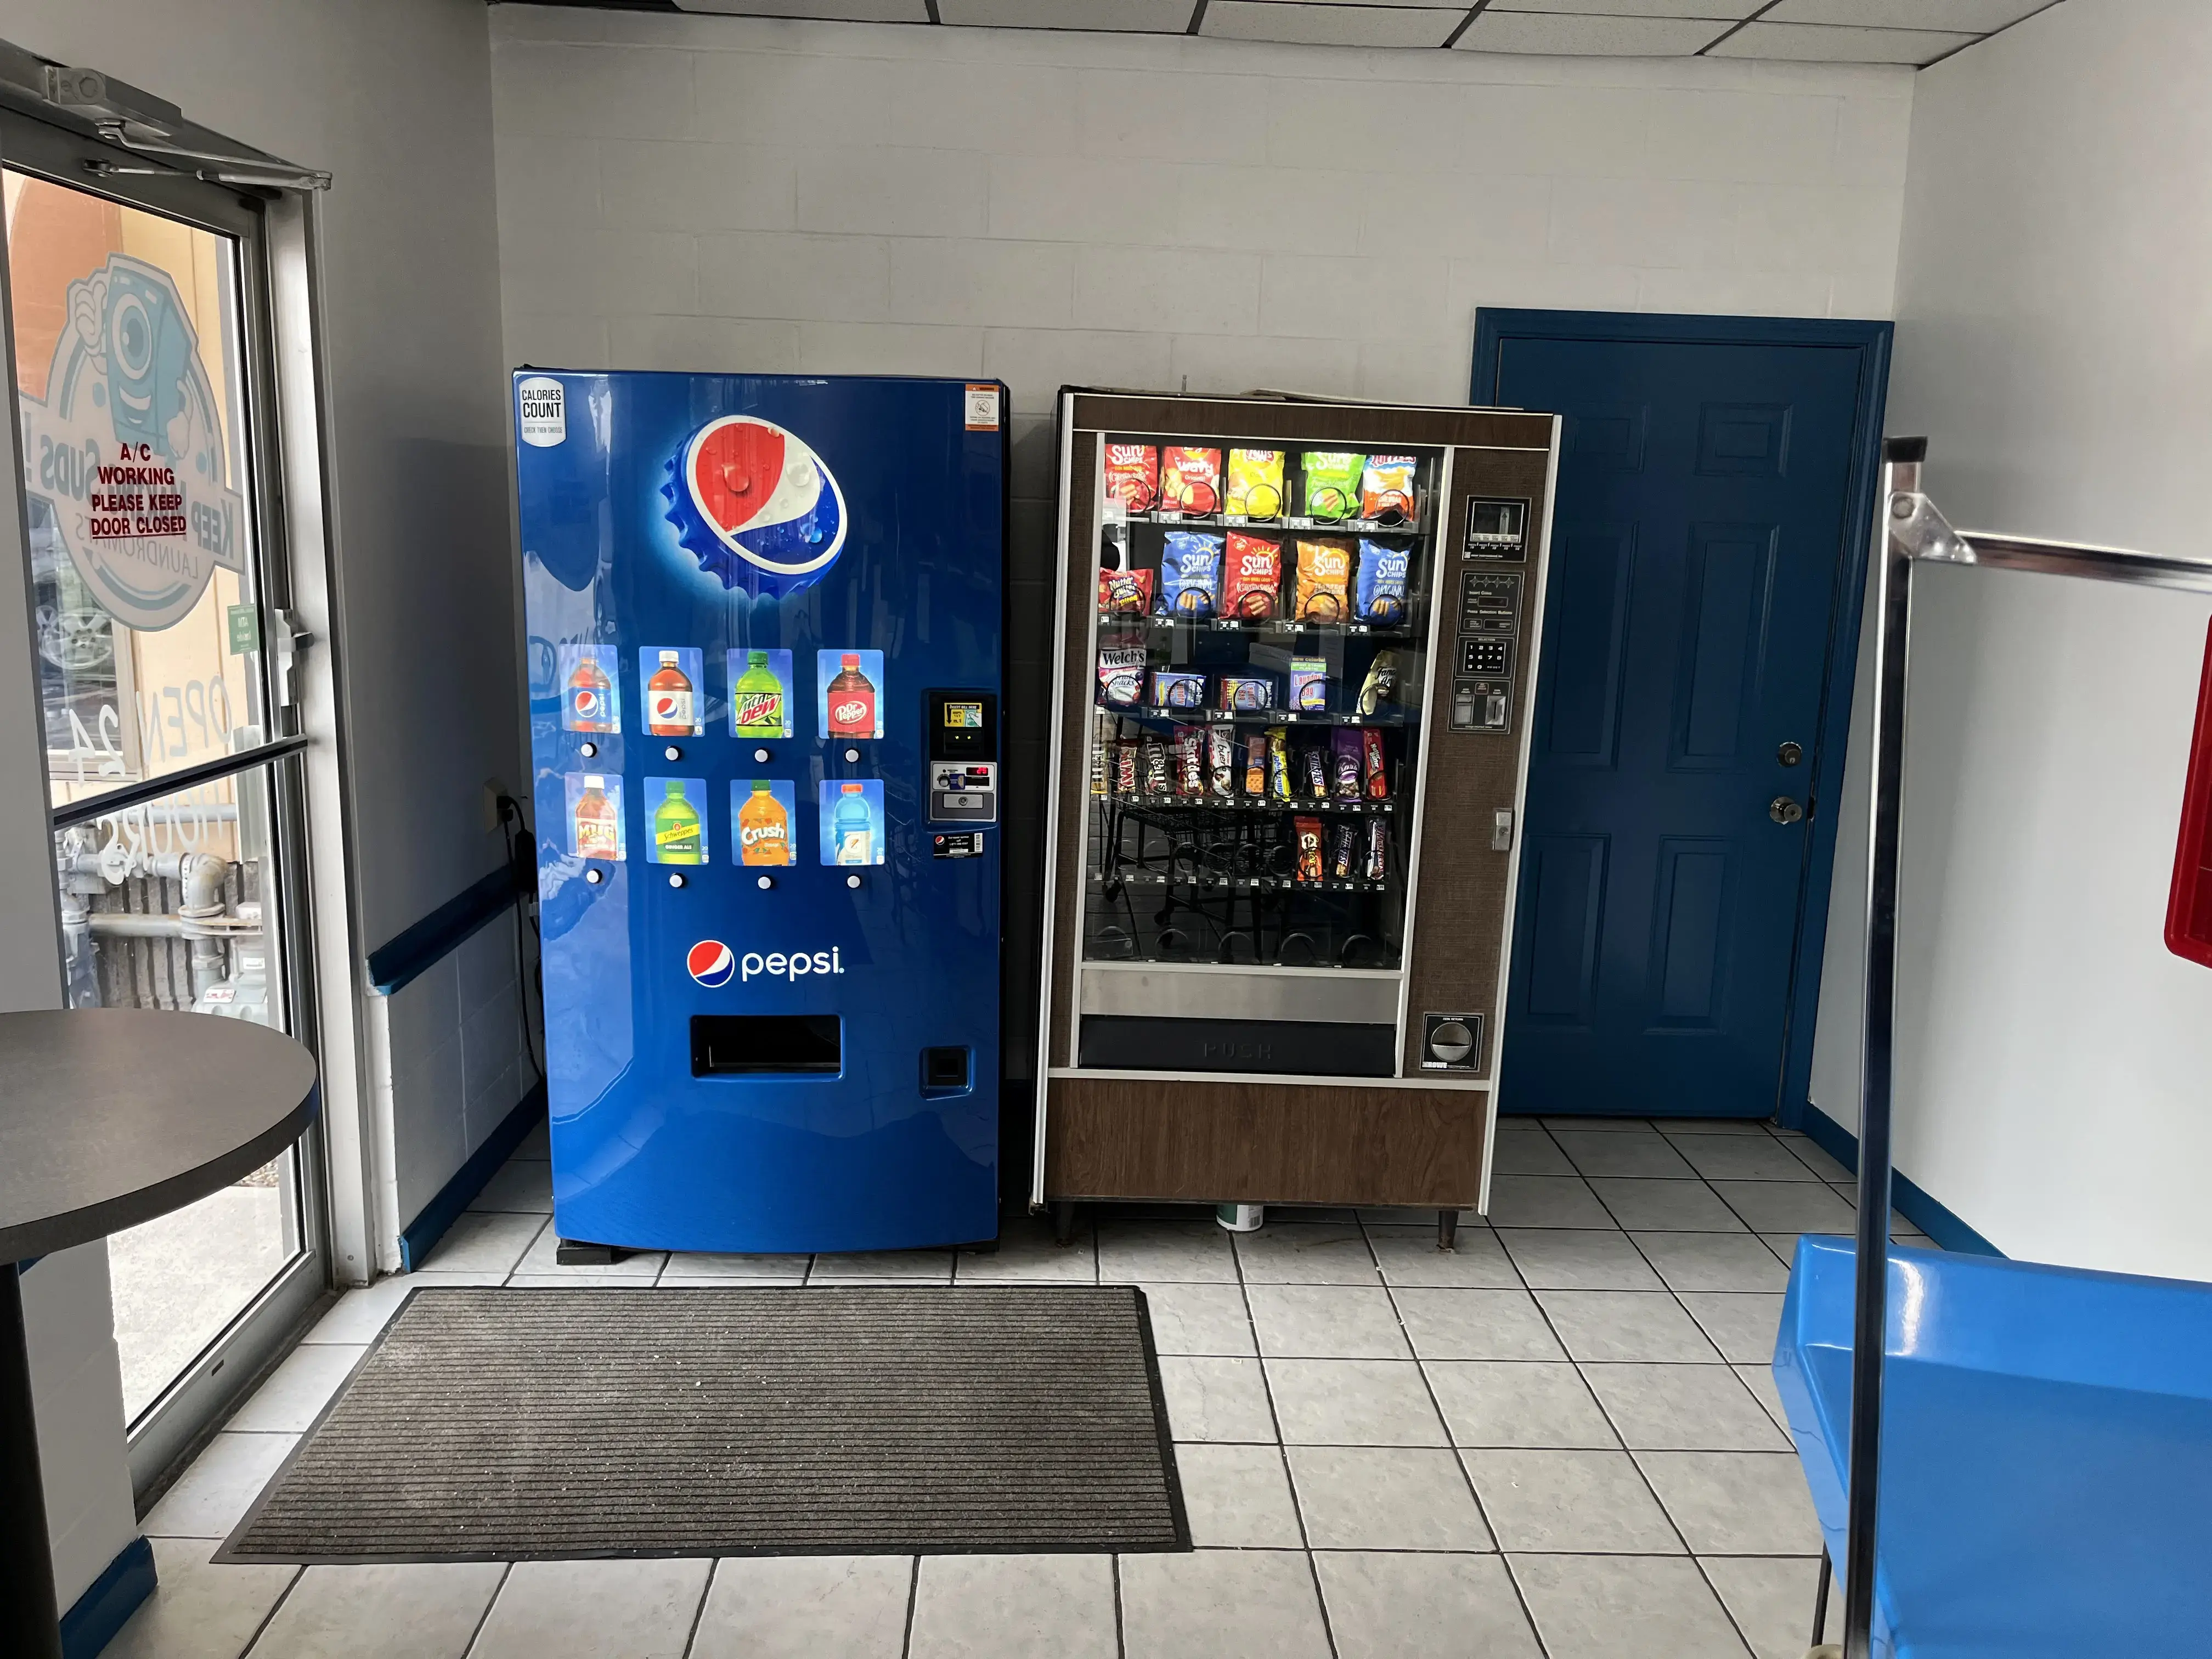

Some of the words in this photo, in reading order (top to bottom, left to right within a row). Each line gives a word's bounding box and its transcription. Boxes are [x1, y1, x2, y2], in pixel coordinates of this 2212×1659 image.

[522, 390, 561, 400] CALORIES
[523, 402, 561, 418] COUNT
[120, 441, 151, 462] A/C
[1111, 445, 1145, 465] Sun
[97, 466, 174, 486] WORKING
[92, 494, 144, 512] PLEASE
[149, 494, 182, 511] KEEP
[91, 517, 131, 535] DOOR
[136, 516, 187, 533] CLOSED
[1180, 554, 1213, 573] Sun
[1240, 555, 1273, 575] Sun
[1314, 555, 1345, 576] Sun
[1376, 558, 1408, 579] Sun
[1109, 577, 1133, 591] Nutter
[1103, 650, 1145, 665] Welch's
[1294, 673, 1322, 686] Laundry
[1176, 681, 1185, 704] aundry
[1238, 690, 1246, 701] Bag
[1246, 683, 1256, 707] Laundry
[1302, 687, 1313, 697] Bag
[838, 706, 865, 721] Pepper
[846, 703, 857, 713] Dr
[1369, 752, 1379, 769] Butter
[1370, 743, 1381, 760] Nutter
[1183, 737, 1200, 788] Skittles
[579, 824, 615, 841] MUG
[664, 828, 693, 841] Schweppes
[741, 822, 785, 845] Crush
[1205, 1042, 1271, 1060] PUSH
